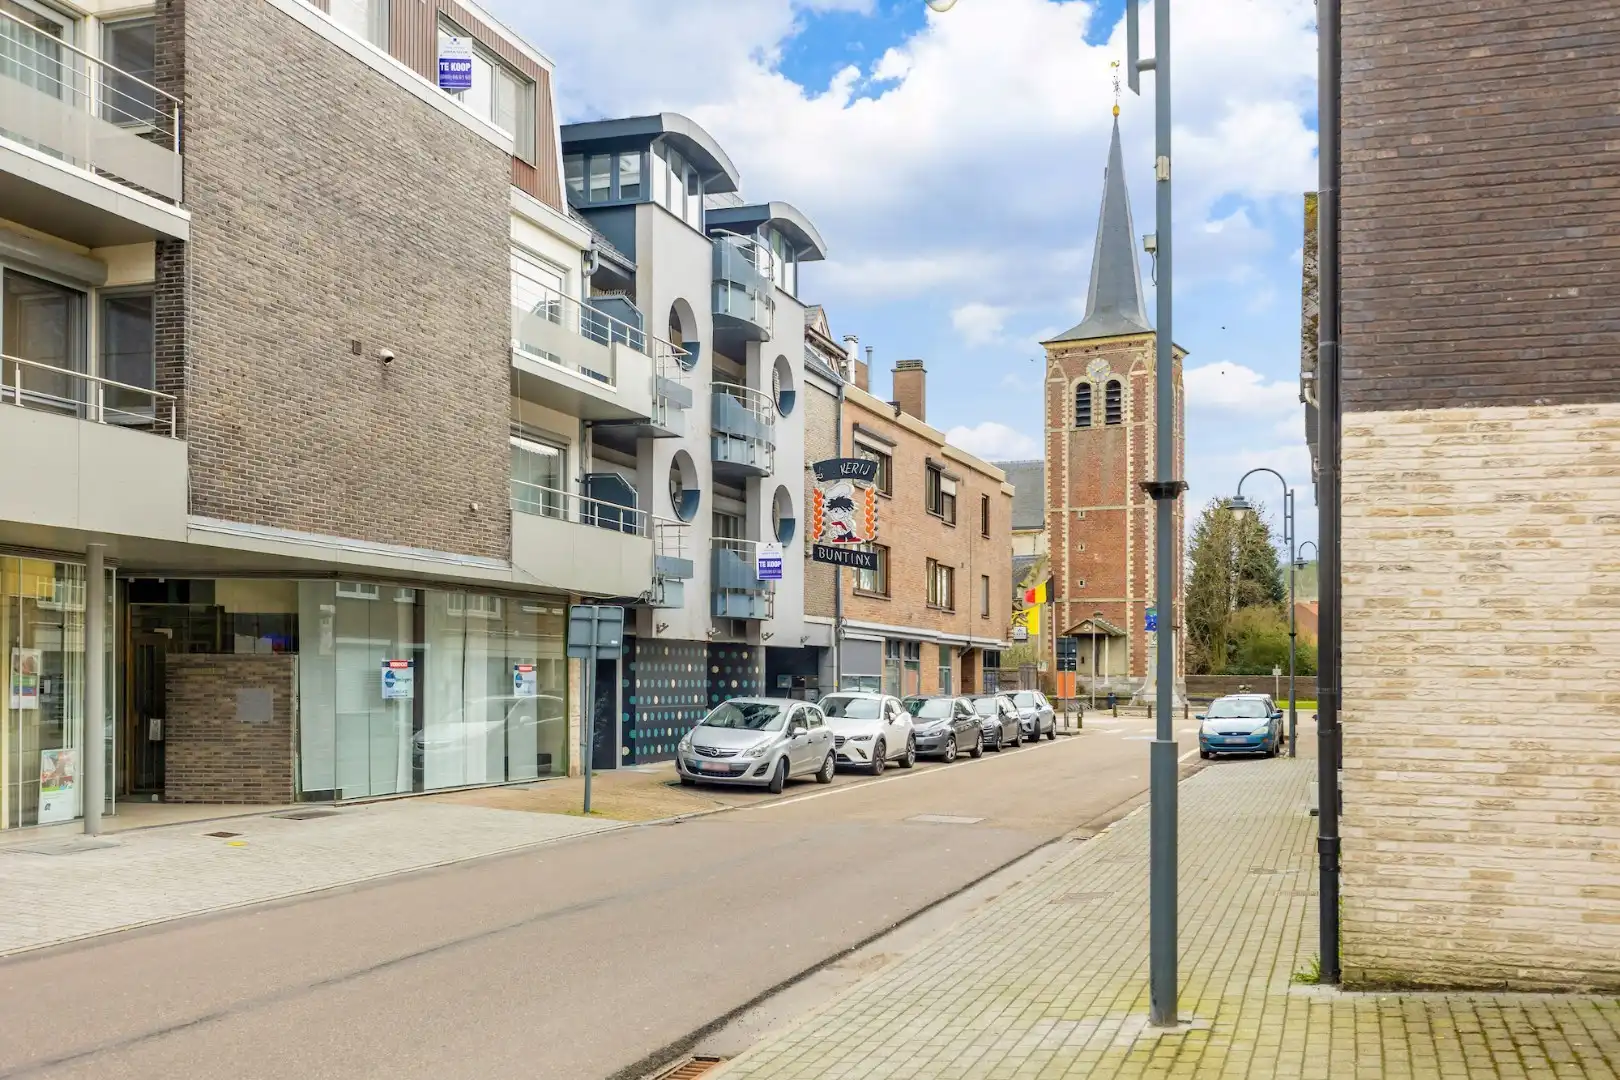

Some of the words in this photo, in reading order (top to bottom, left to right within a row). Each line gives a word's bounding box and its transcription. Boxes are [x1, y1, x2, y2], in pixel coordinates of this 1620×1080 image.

[440, 62, 449, 71] TE
[451, 62, 471, 72] KOOP
[818, 547, 871, 567] BUNTINX
